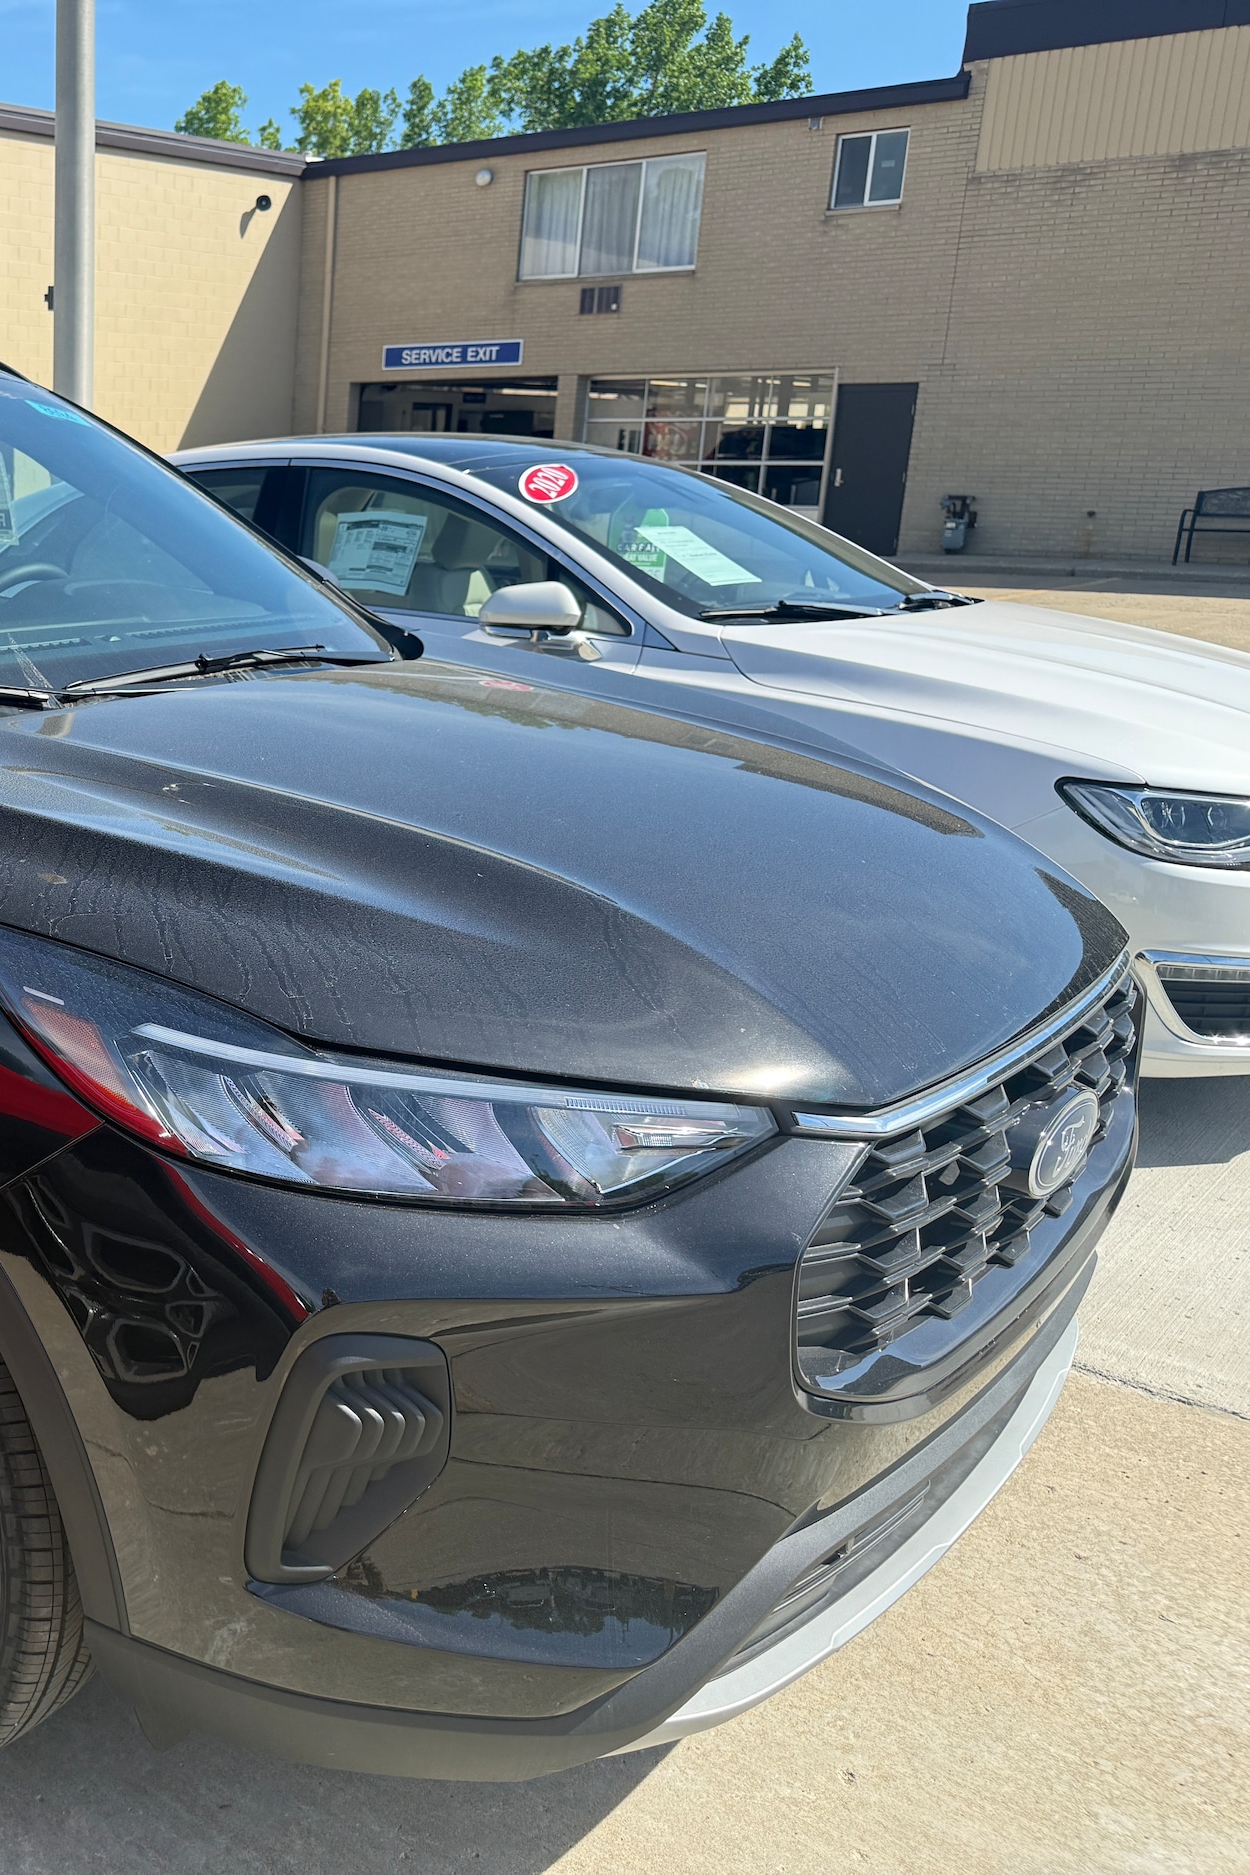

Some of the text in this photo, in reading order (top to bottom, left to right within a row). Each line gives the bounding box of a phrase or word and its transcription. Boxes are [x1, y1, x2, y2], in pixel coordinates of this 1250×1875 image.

[401, 346, 500, 365] SERVICE EXIT
[528, 467, 569, 499] 2020
